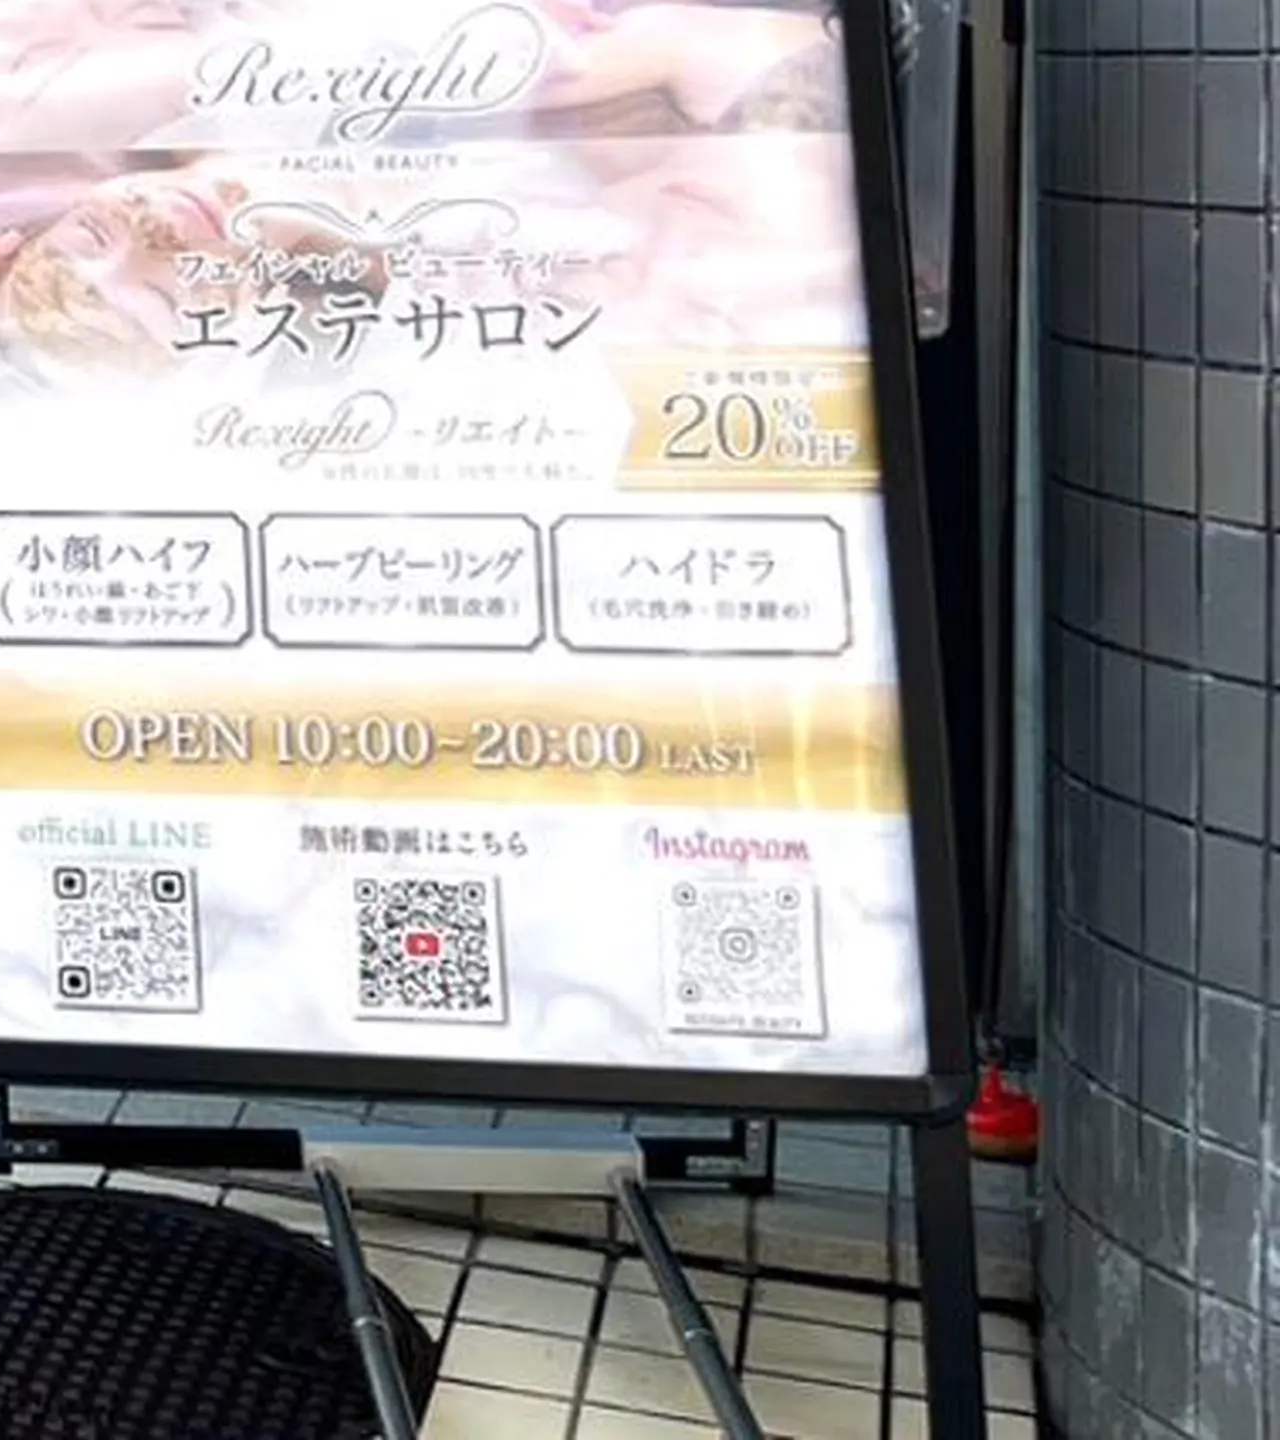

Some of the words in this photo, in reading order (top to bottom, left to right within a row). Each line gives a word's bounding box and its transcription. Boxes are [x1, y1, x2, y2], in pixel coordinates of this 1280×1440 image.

[279, 155, 357, 173] FACIAL
[372, 153, 460, 172] BEAUTY
[177, 248, 367, 287] フェイシャル
[170, 295, 604, 362] エステサロン
[15, 534, 213, 577] 小顔ハイフ
[278, 545, 525, 584] ハーブピーリング
[618, 547, 777, 585] ハイドラ
[79, 707, 253, 762] OPEN
[657, 741, 757, 774] LAST
[16, 817, 118, 848] official
[126, 820, 213, 850] LINE
[298, 823, 529, 858] 施術動画はこちら
[643, 825, 812, 866] Instagram
[99, 924, 143, 942] LINE
